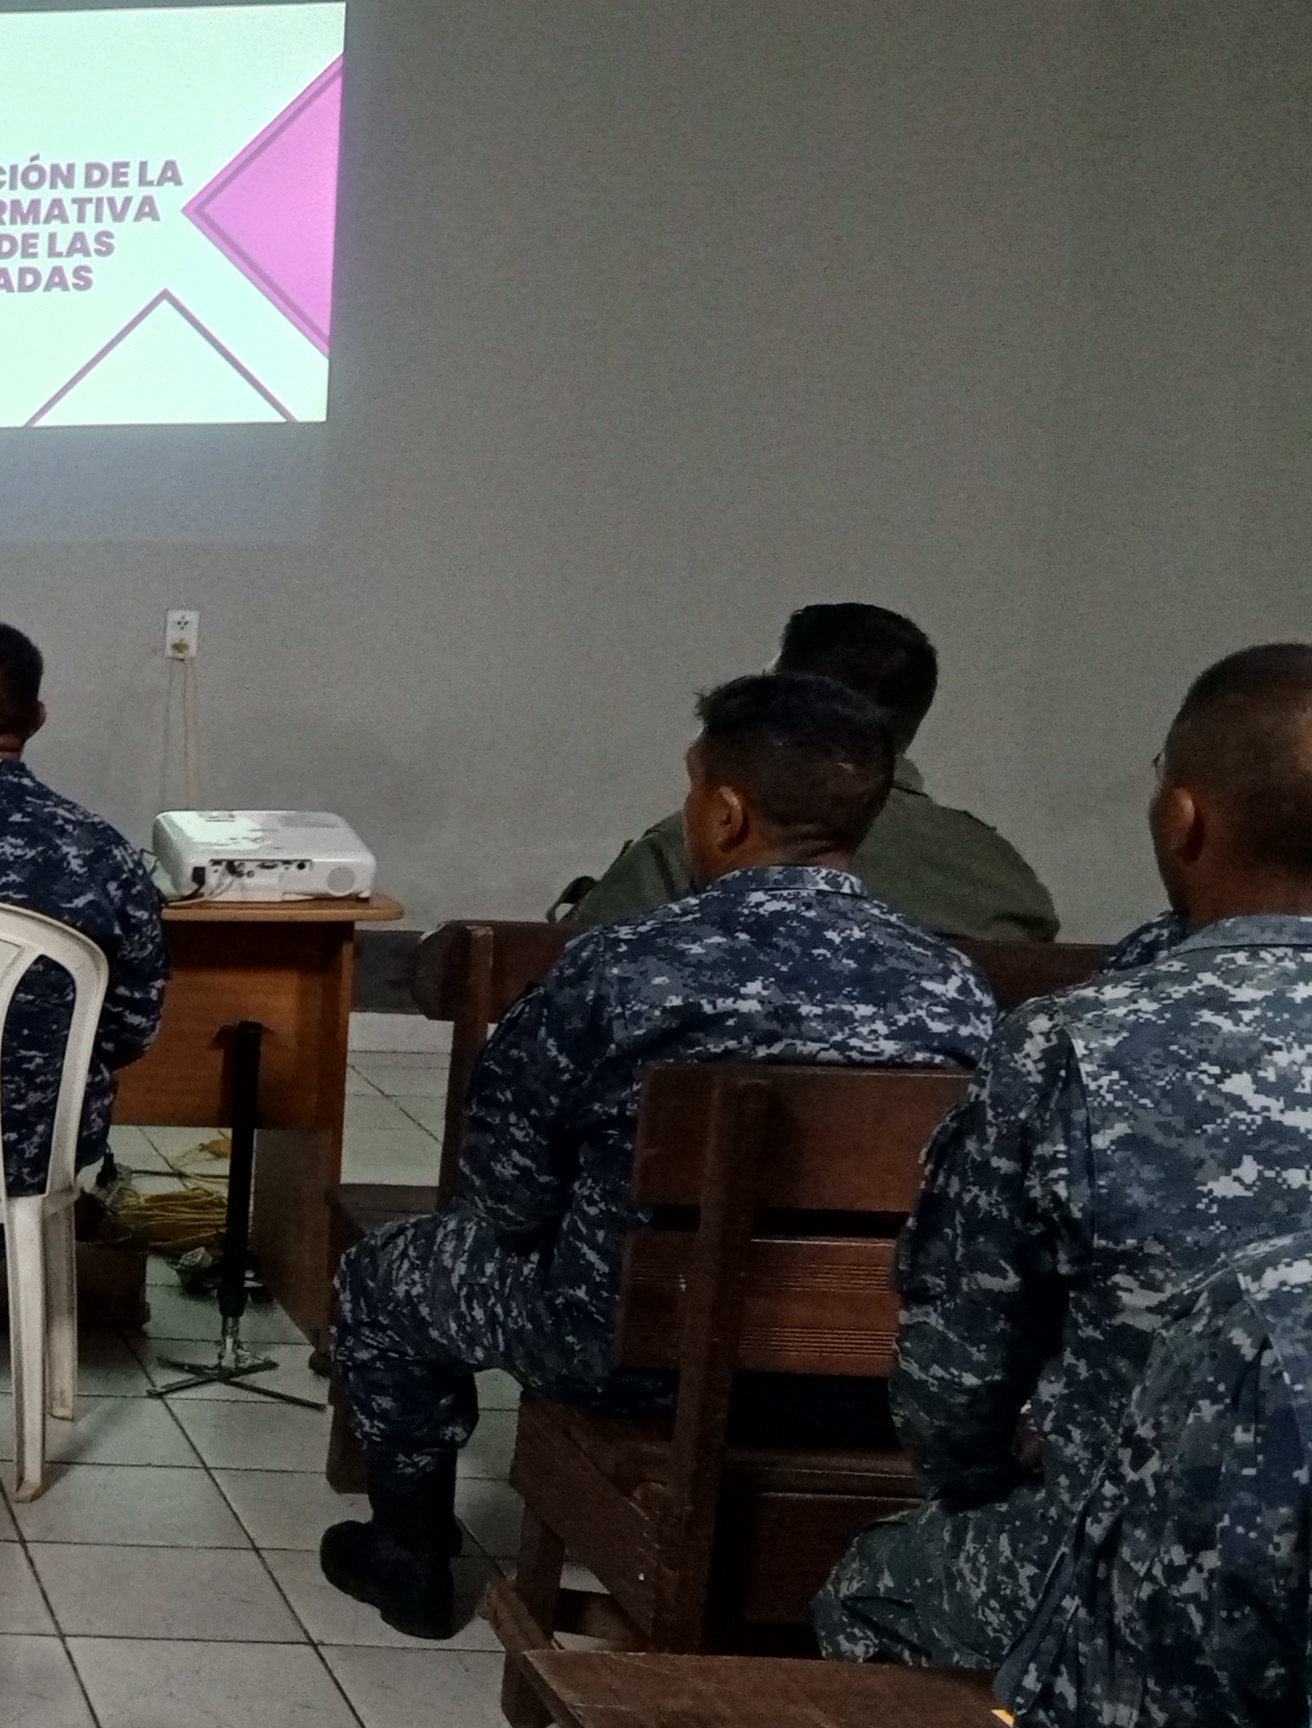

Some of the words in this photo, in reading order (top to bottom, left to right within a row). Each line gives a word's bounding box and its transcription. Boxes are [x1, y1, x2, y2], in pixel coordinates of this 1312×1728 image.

[84, 161, 130, 189] DE
[138, 160, 183, 188] LA
[47, 230, 115, 259] LAS
